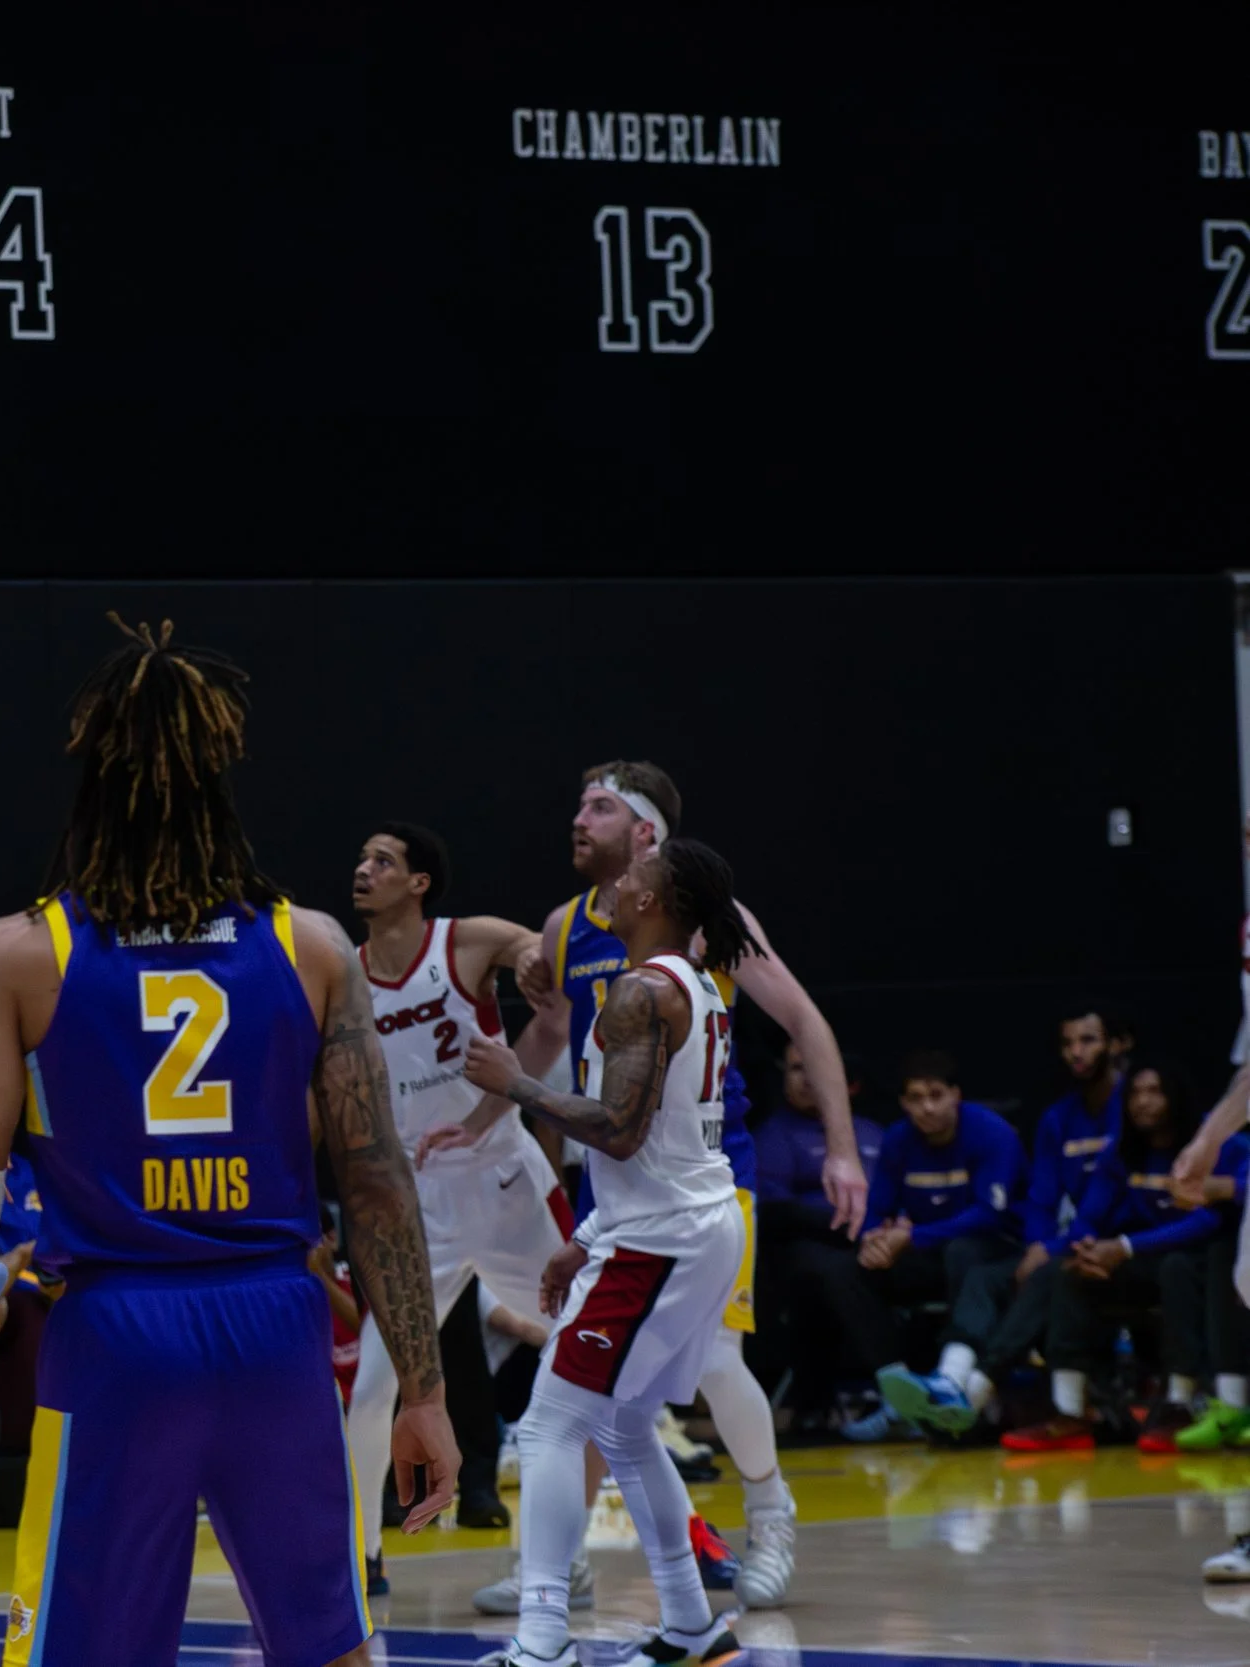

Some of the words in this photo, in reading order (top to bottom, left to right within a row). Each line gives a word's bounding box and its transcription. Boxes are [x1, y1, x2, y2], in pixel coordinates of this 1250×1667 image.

[511, 107, 782, 167] CHAMBERLAIN
[593, 205, 714, 354] 13
[374, 997, 446, 1035] ORCE
[433, 1019, 461, 1064] 2
[138, 968, 233, 1136] 2
[142, 1156, 250, 1212] DAVIS
